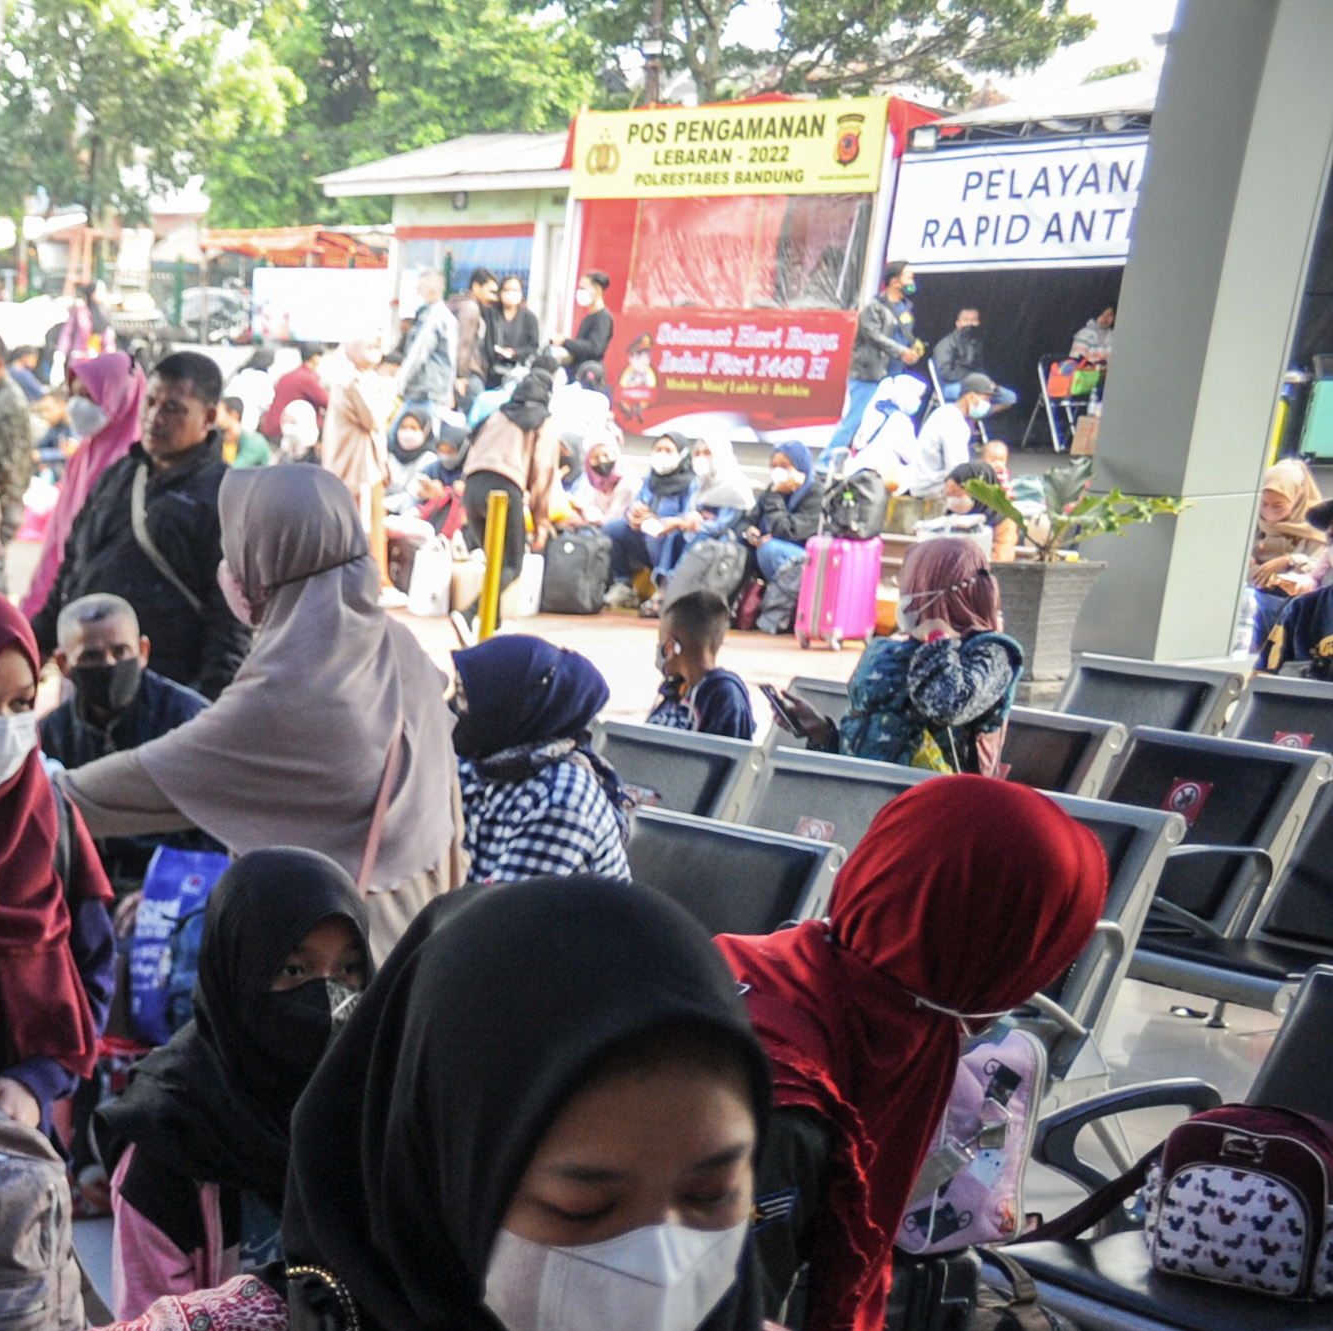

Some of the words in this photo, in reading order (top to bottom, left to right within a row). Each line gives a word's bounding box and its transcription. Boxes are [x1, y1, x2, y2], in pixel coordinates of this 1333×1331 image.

[627, 121, 667, 144] POS
[674, 114, 826, 142] PENGAMANAN
[654, 149, 733, 166] LEBARAN
[748, 146, 790, 163] 2022
[634, 171, 729, 186] POLRESTABES
[735, 169, 804, 184] BANDUNG
[962, 160, 1140, 201] PELAYAN
[921, 214, 1030, 248] RAPID
[1041, 208, 1134, 244] ANT
[656, 322, 733, 347] Selamat
[735, 324, 783, 349] Hari
[785, 326, 839, 355] Raya
[757, 355, 805, 379] 1443
[807, 356, 830, 380] H
